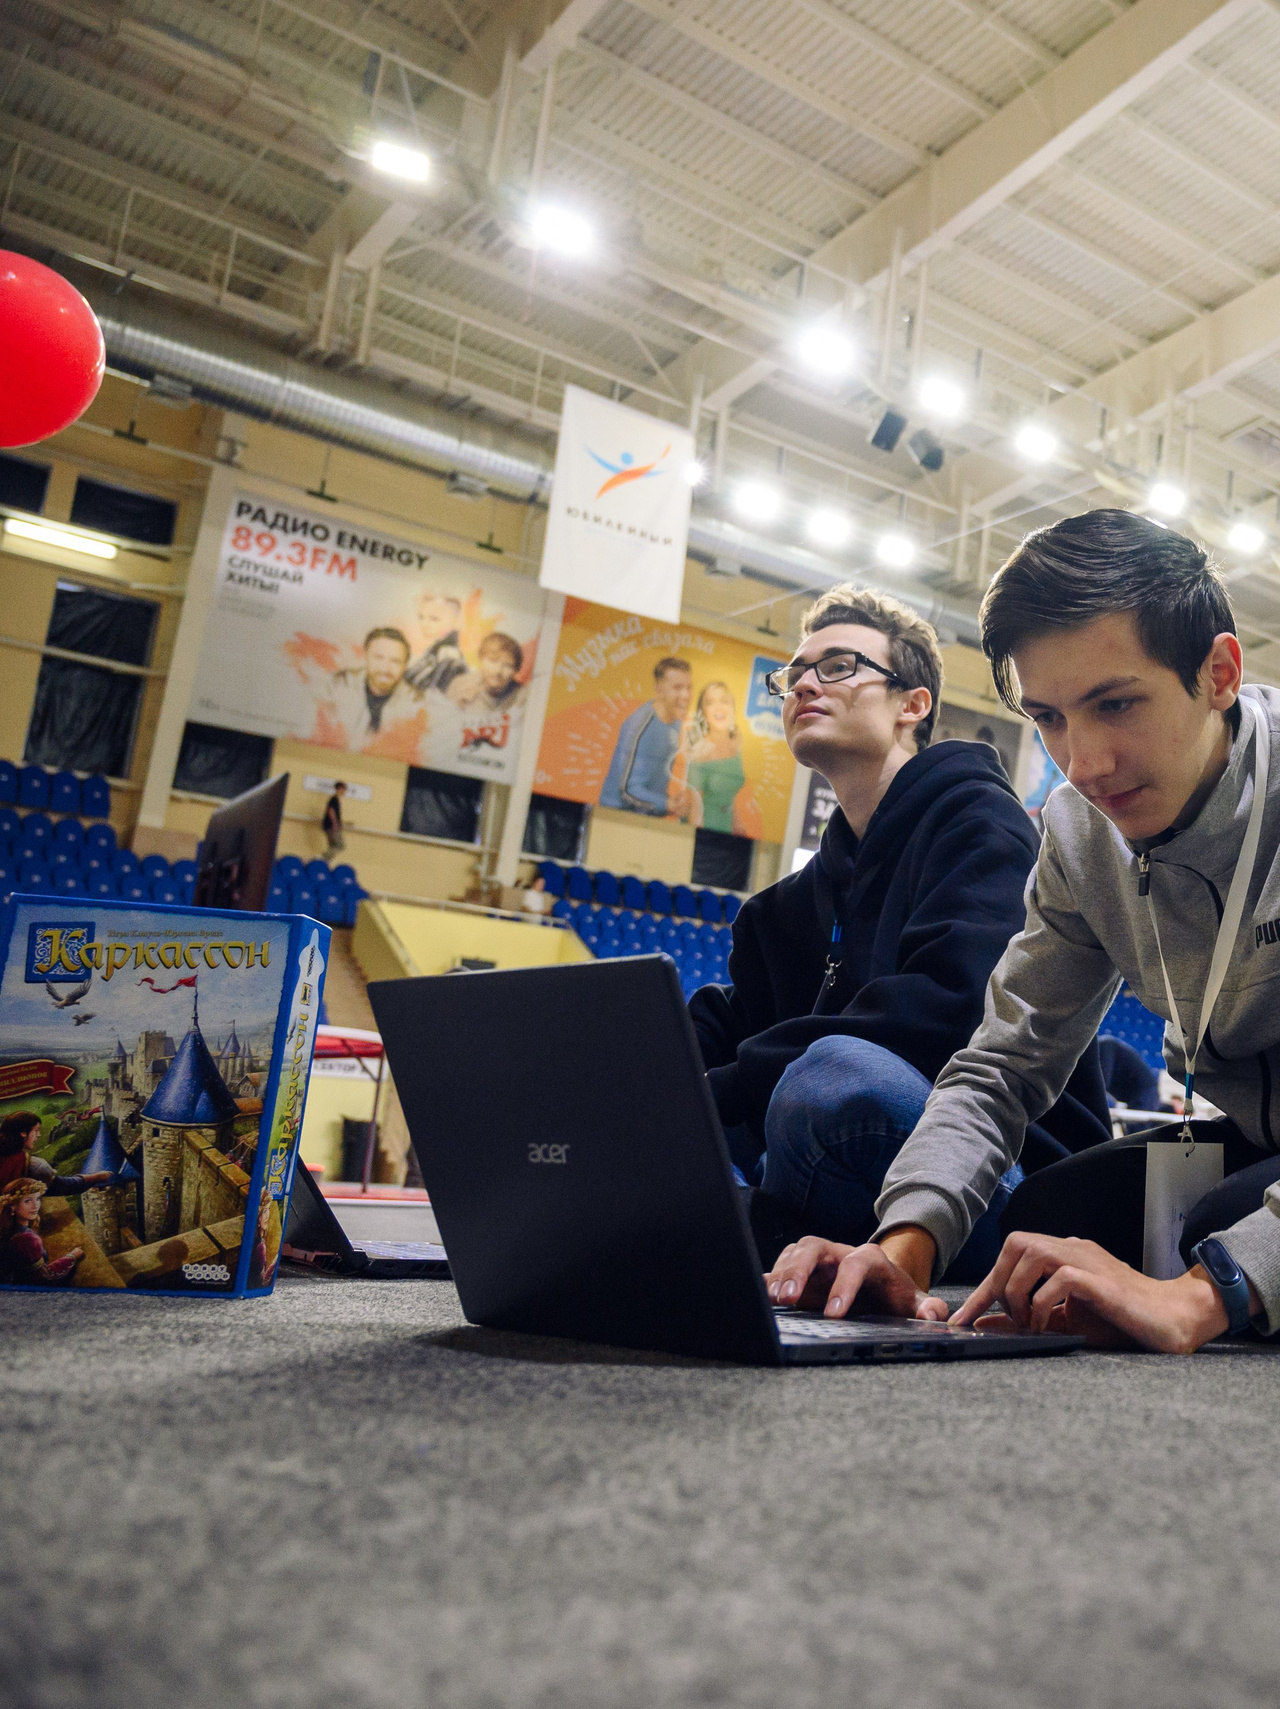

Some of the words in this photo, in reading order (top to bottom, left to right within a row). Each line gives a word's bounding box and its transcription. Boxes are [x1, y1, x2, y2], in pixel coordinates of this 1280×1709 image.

[231, 524, 357, 582] 89.3FM
[236, 501, 330, 542] РАДИО
[336, 530, 429, 570] ENERGY
[36, 929, 273, 981] Каркассон
[527, 1142, 571, 1163] acer
